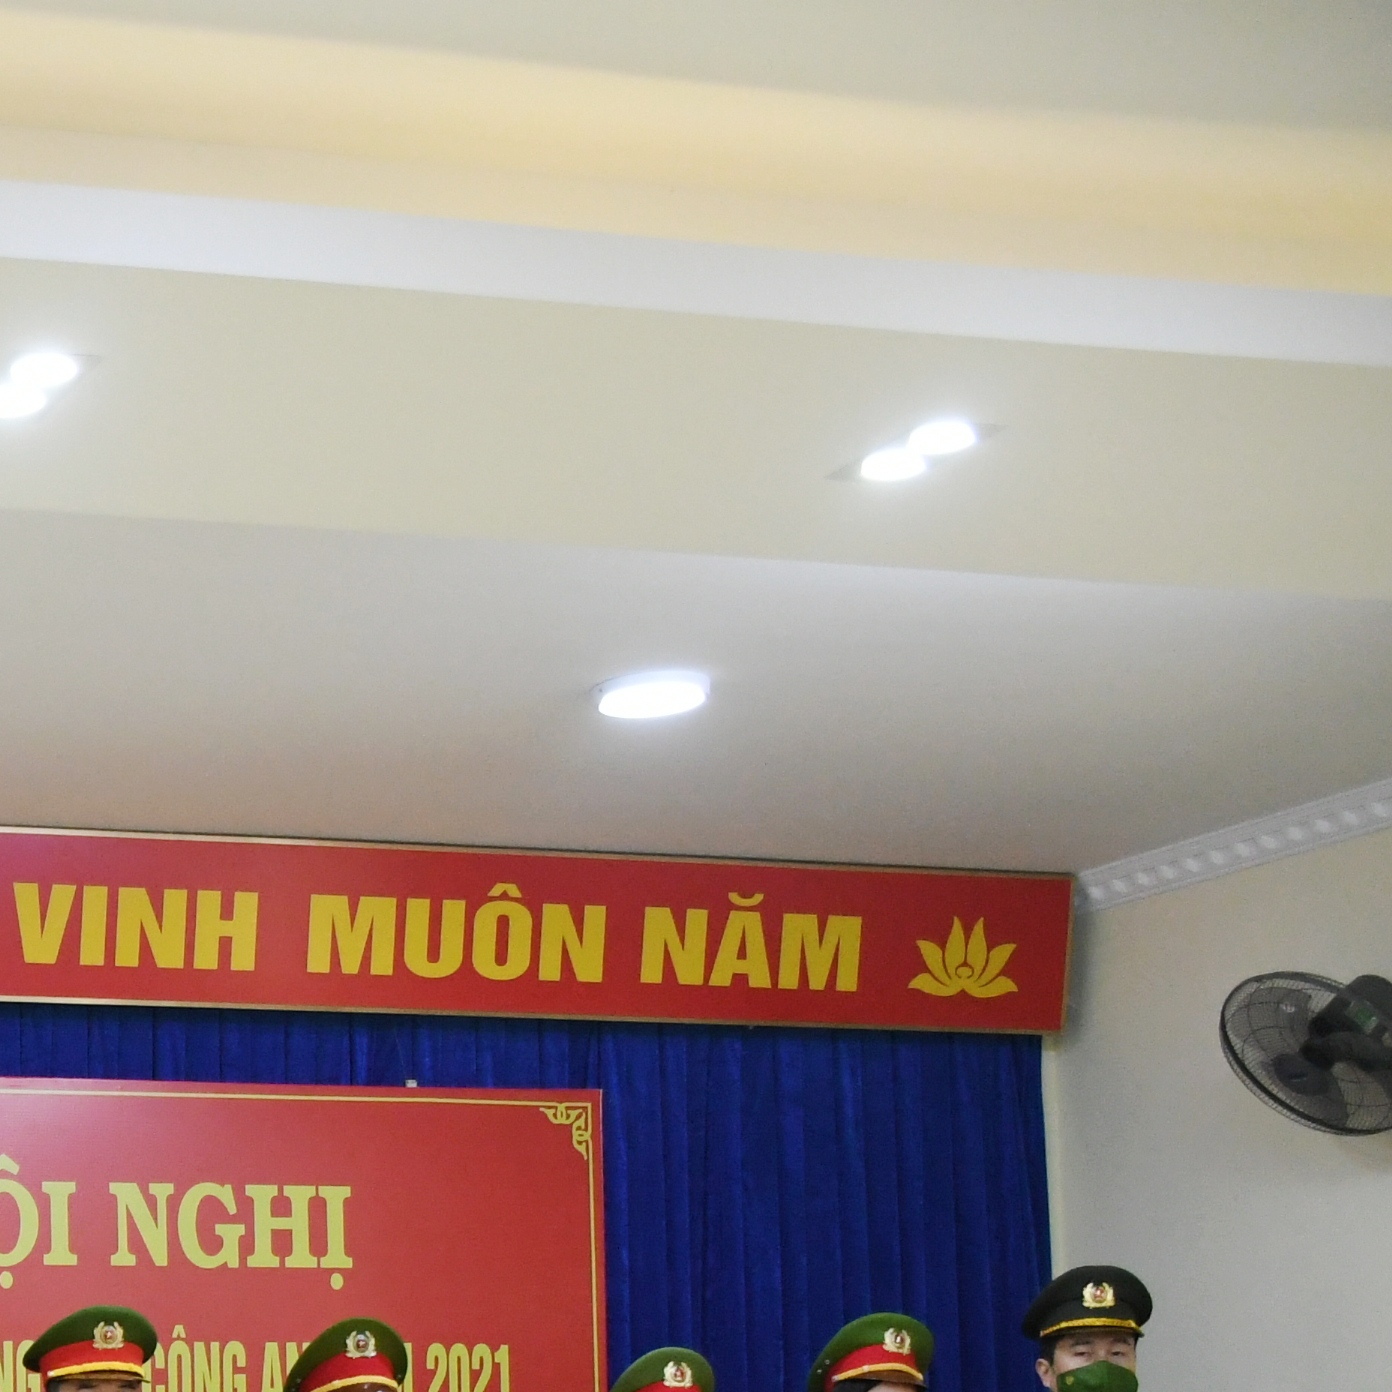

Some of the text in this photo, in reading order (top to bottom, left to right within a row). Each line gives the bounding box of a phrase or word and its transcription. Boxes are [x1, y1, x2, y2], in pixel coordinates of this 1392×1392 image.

[14, 883, 259, 970] VINH
[307, 882, 607, 983] MUÔN
[641, 892, 862, 992] NĂM
[108, 1181, 355, 1290] NGHỊ
